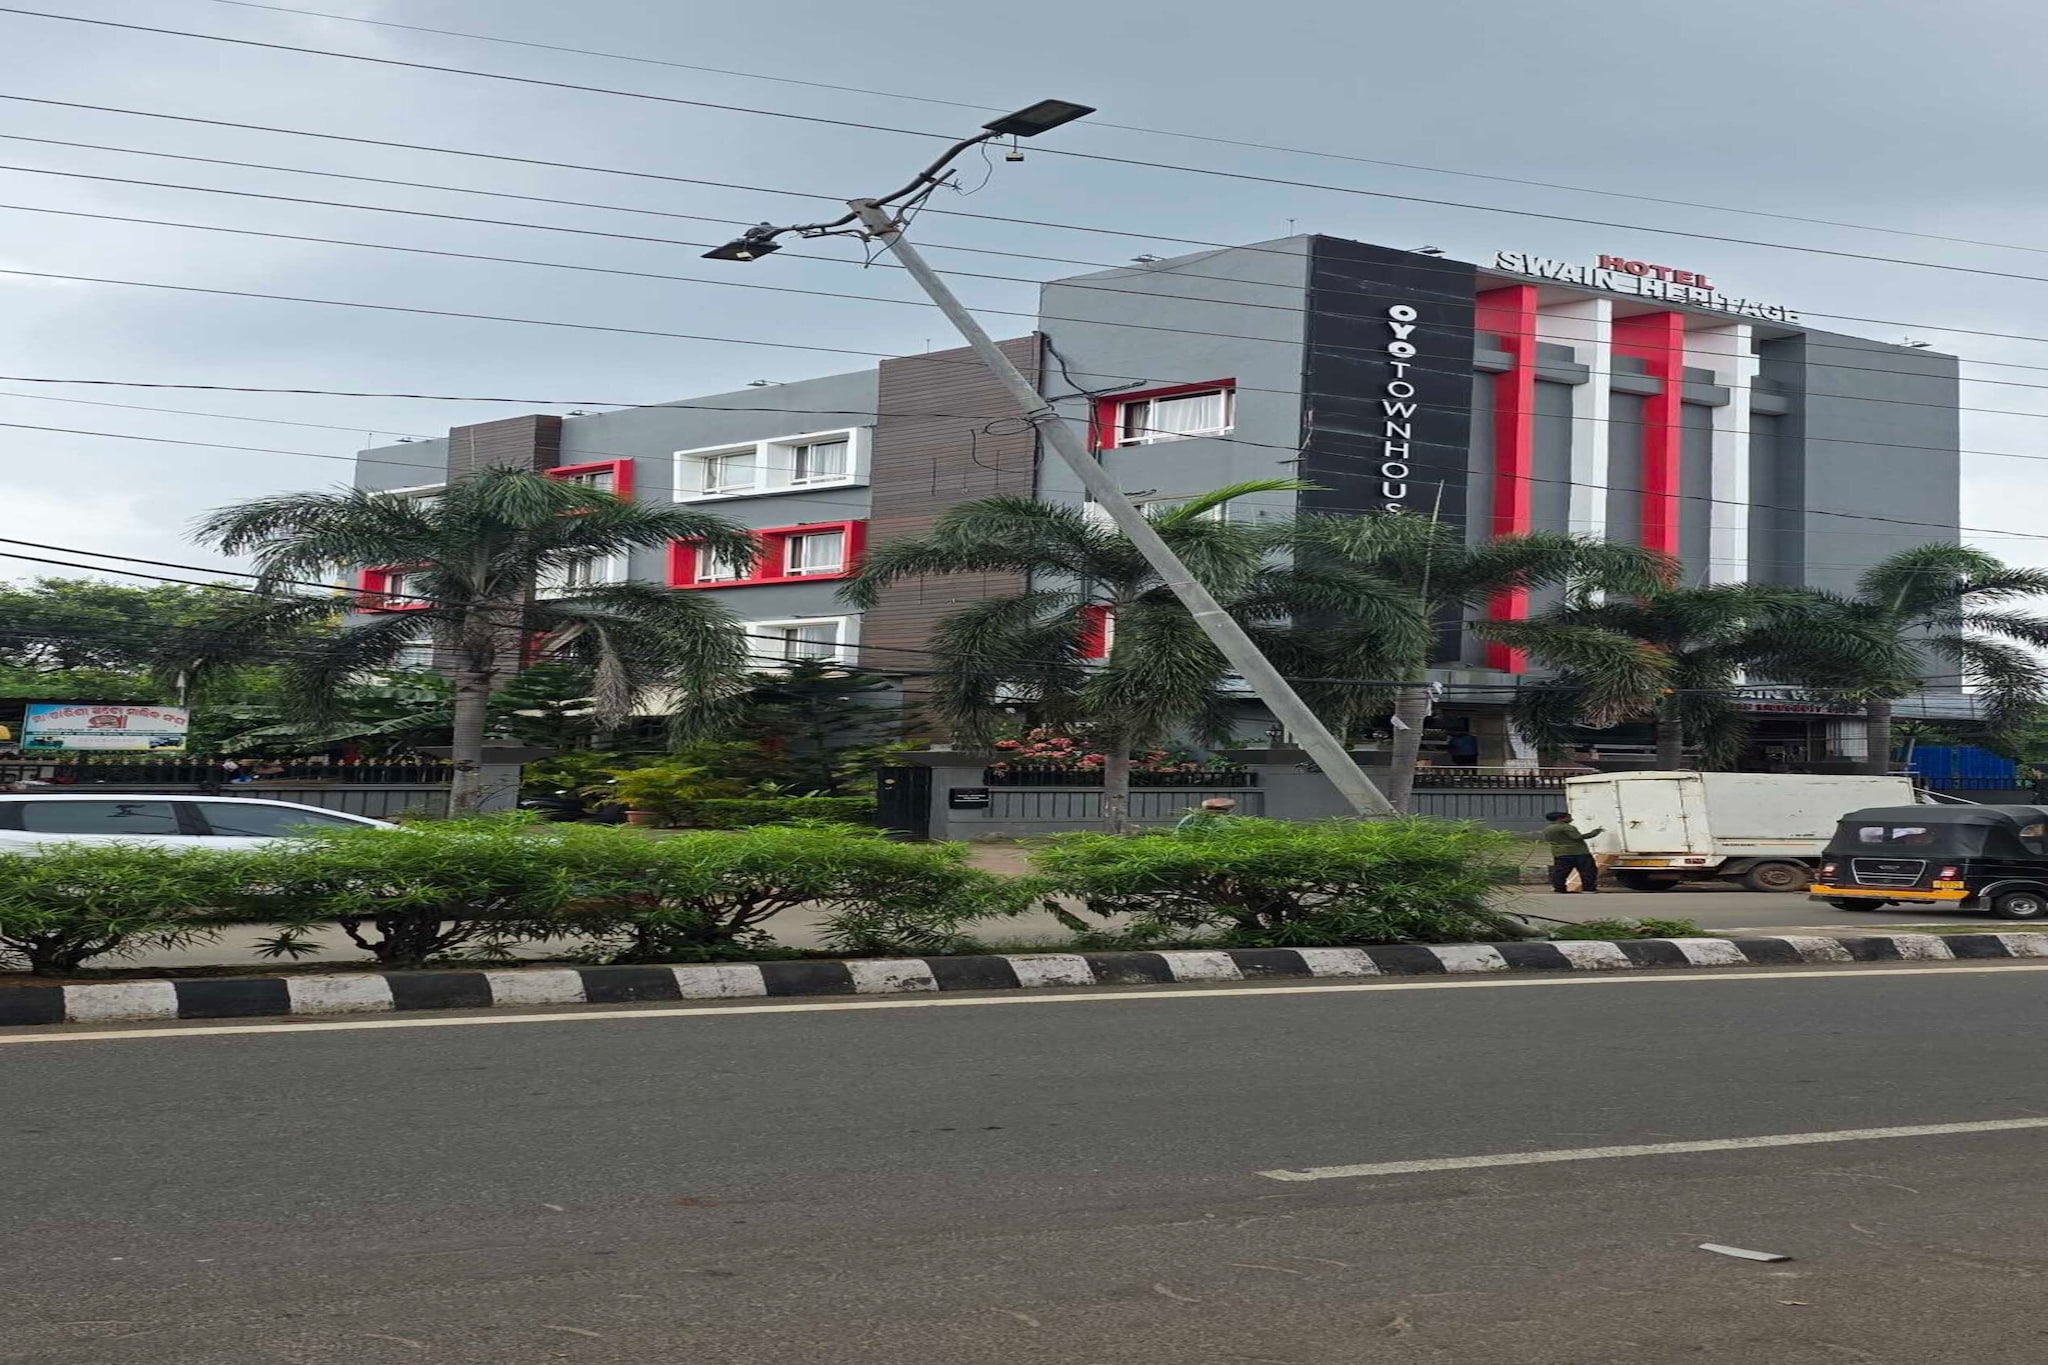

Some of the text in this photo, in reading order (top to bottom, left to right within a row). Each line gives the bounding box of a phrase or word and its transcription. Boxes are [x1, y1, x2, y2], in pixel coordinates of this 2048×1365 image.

[1494, 249, 1801, 326] SWAIN HERITAGE
[1595, 254, 1714, 290] HOTEL
[1382, 304, 1418, 513] OYO TOWNHOUS
